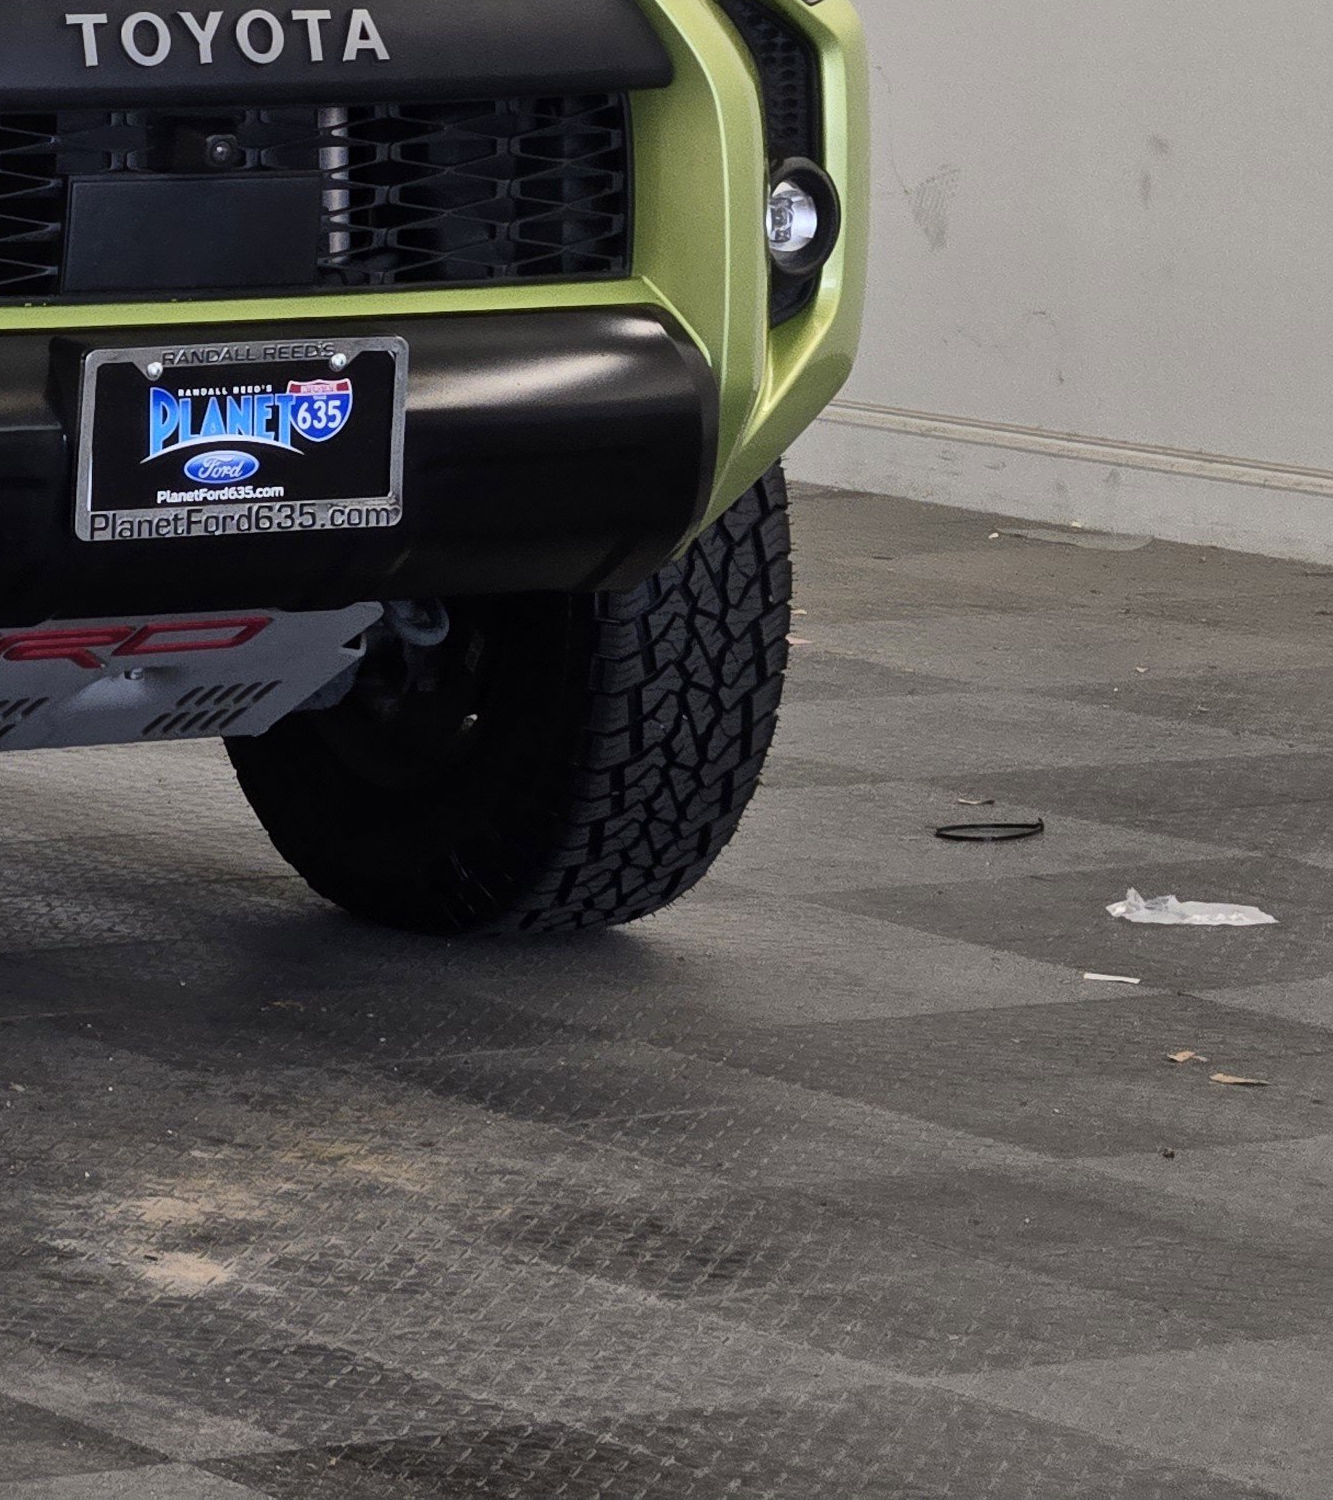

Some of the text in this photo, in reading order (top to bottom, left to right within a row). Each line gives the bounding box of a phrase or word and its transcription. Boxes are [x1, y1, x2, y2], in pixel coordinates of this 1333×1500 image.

[65, 8, 390, 67] TOYOTA
[161, 345, 258, 367] RANDALL
[149, 386, 342, 457] PLANET 635
[198, 455, 244, 479] Ford
[156, 485, 285, 504] PlanetFord635.com
[89, 502, 391, 540] PlanetFord635.com
